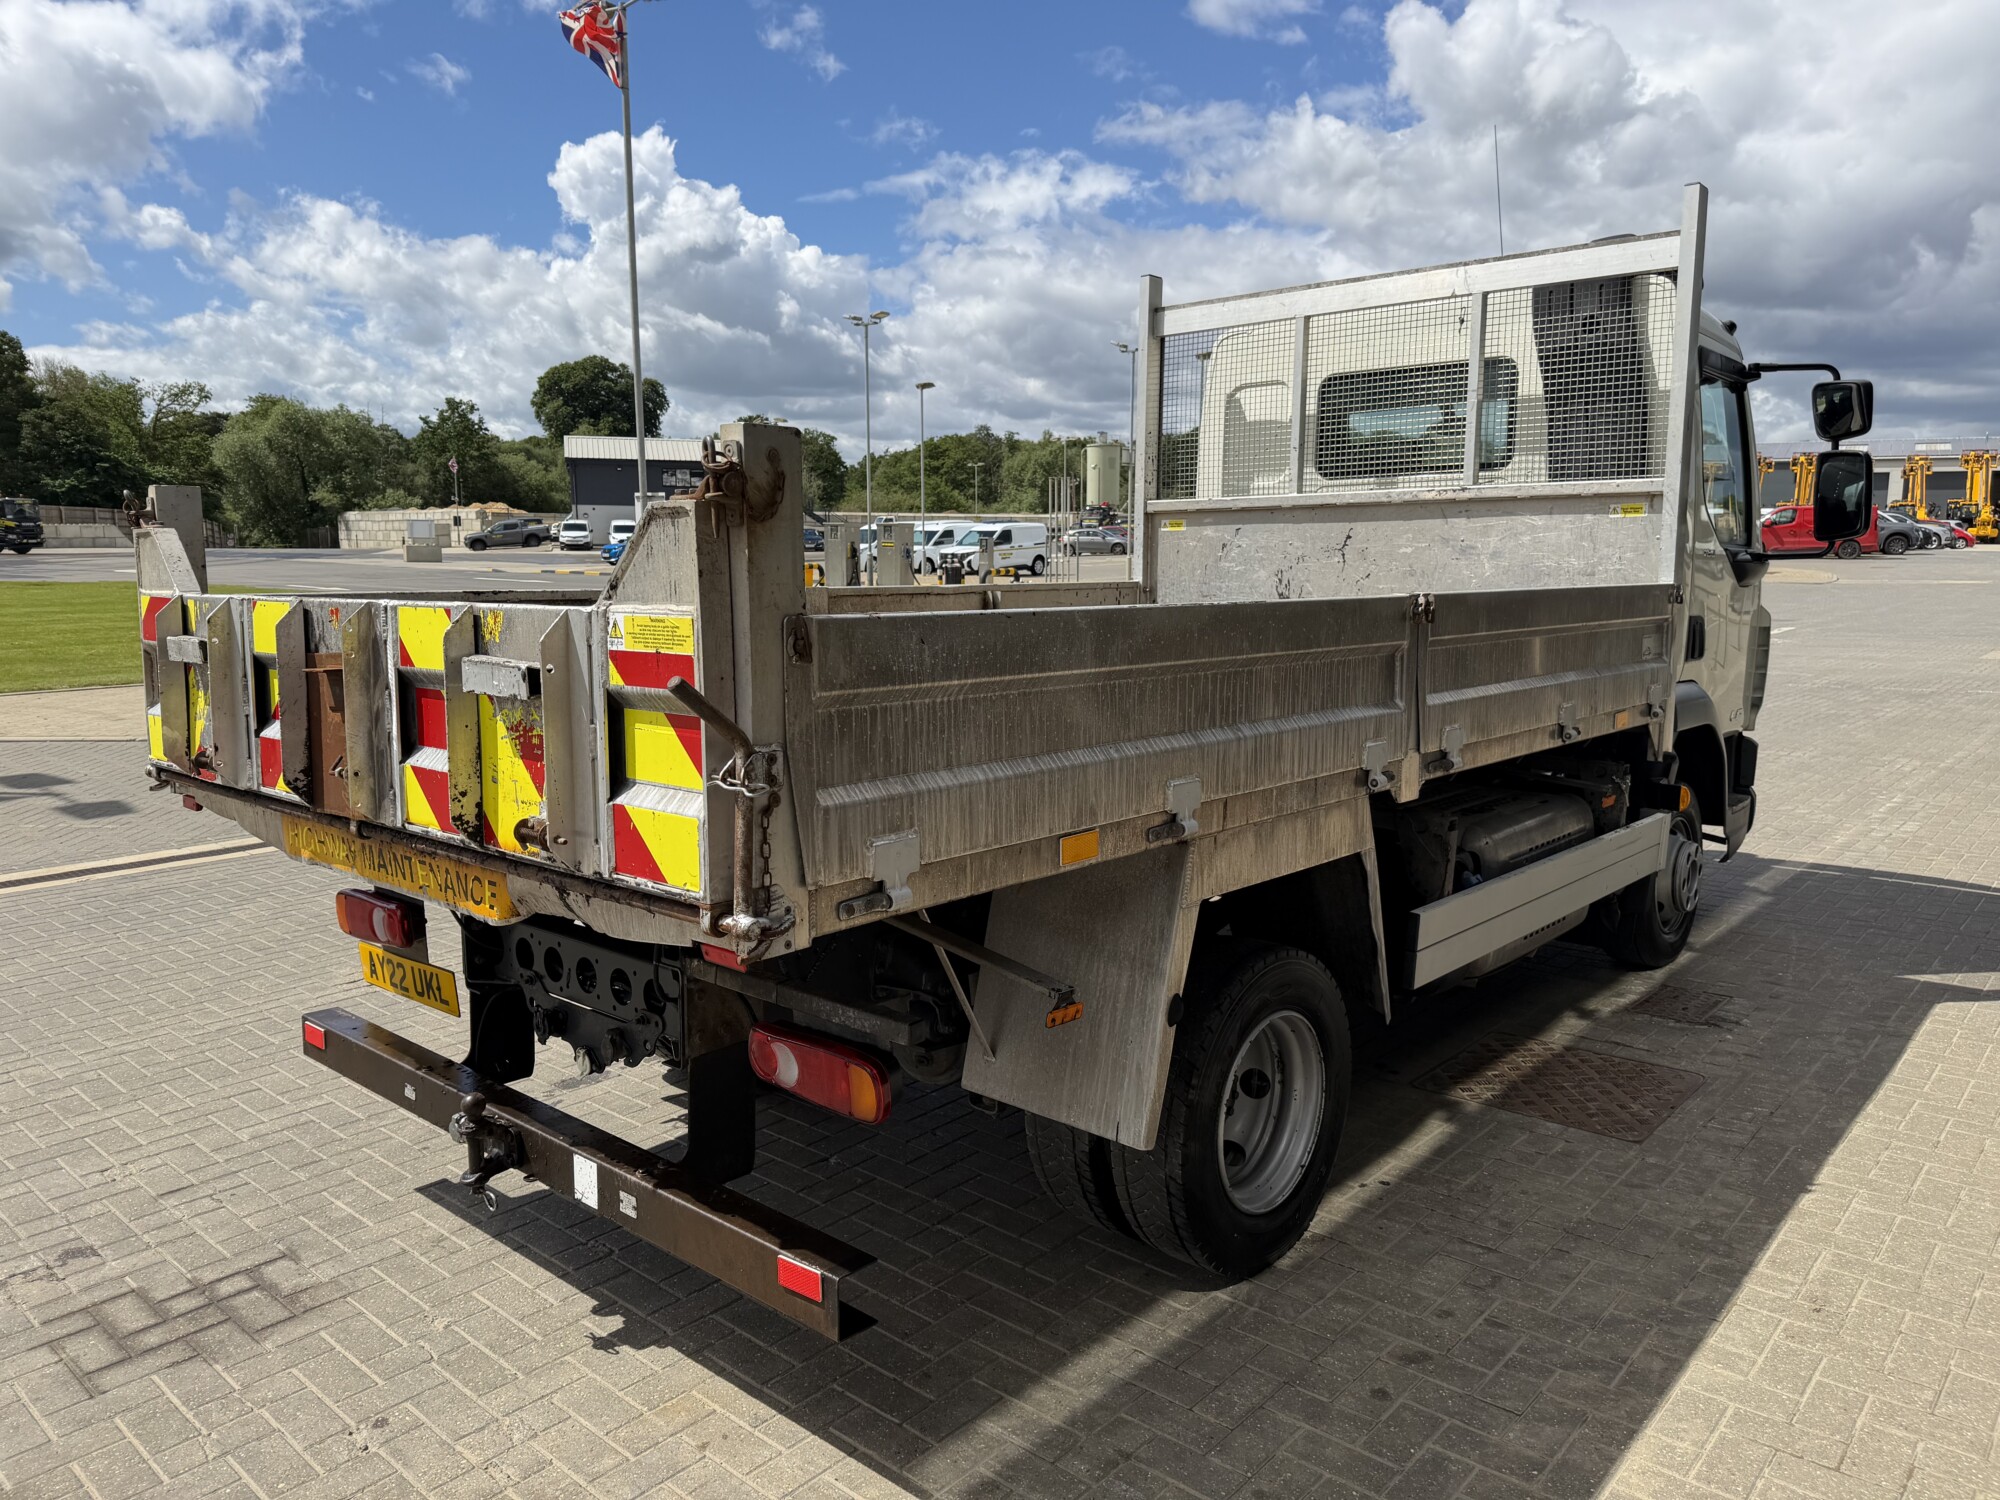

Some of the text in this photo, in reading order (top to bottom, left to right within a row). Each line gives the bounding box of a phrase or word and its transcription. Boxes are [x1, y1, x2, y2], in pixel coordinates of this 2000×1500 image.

[288, 821, 497, 910] HIGHWAY MAINTENANCE
[369, 950, 449, 1006] AY22 UKL
